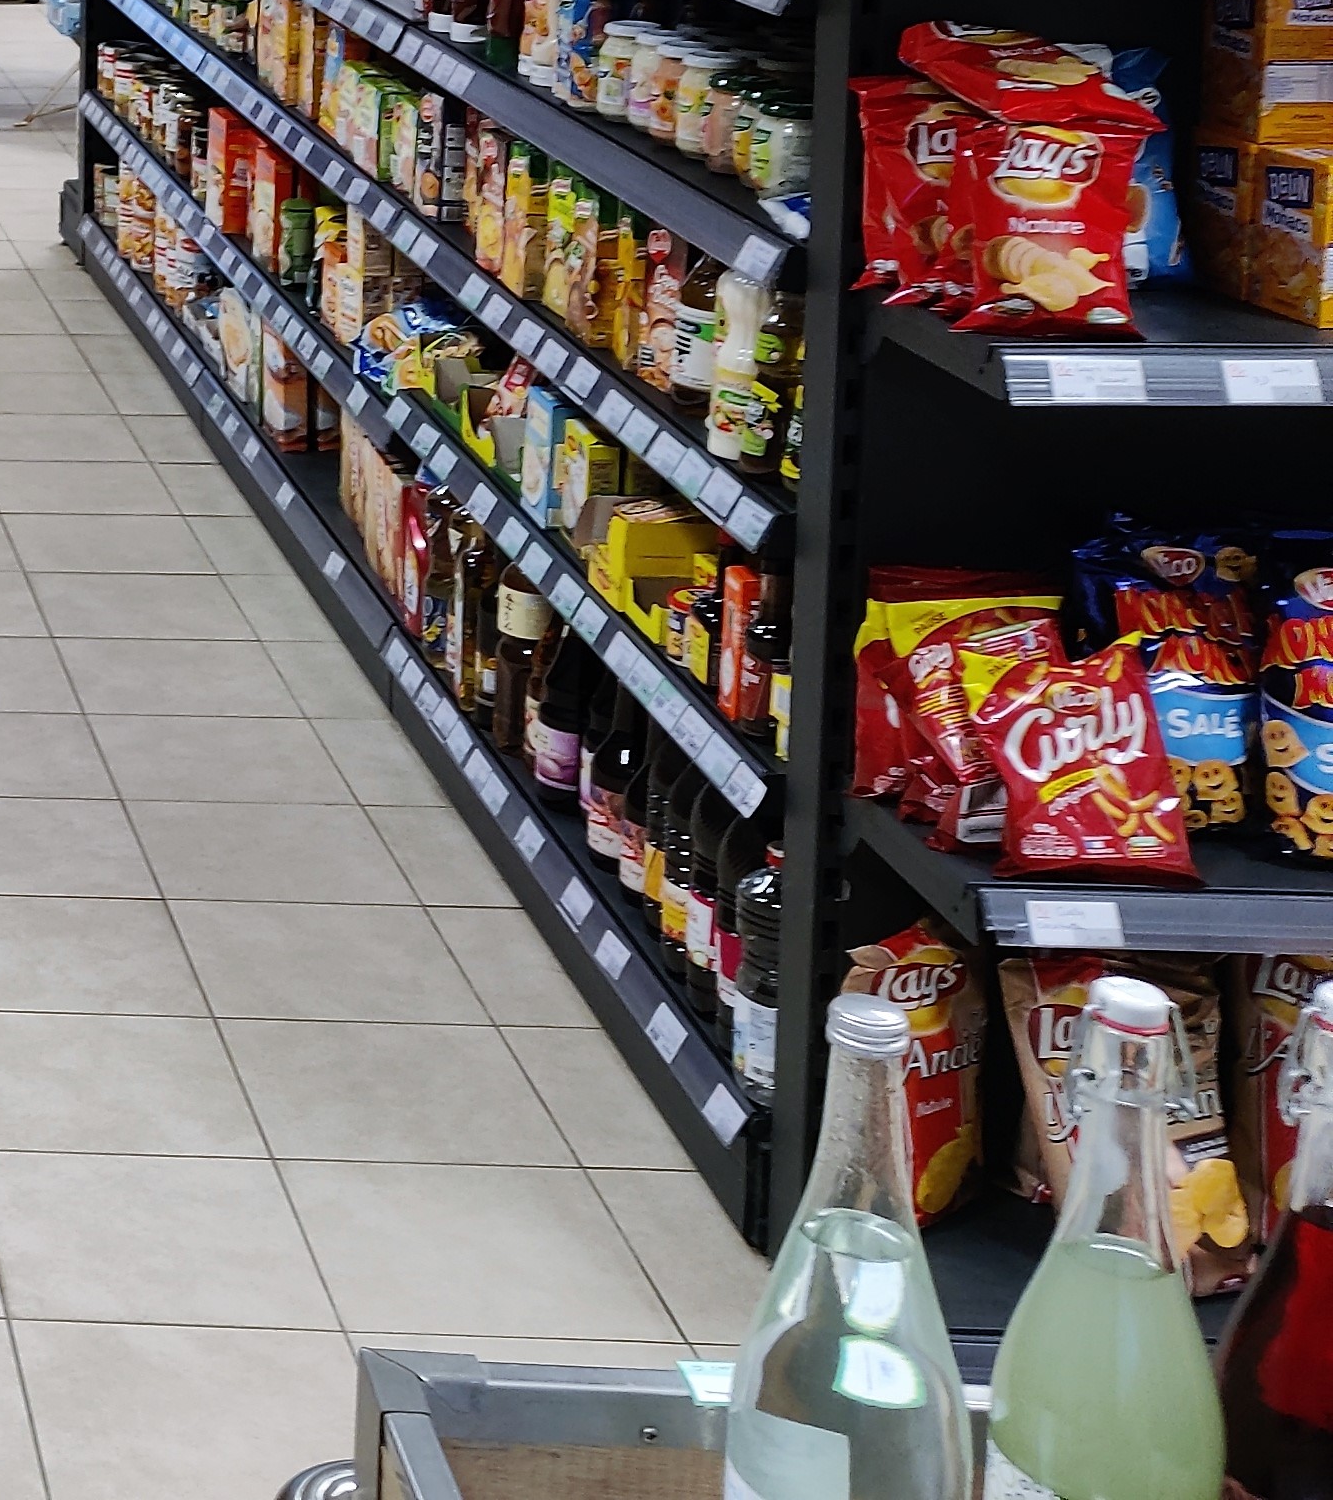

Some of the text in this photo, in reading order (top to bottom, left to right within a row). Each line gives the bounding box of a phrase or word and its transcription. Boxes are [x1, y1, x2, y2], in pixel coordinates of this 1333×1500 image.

[1004, 686, 1148, 783] Curly
[1166, 708, 1244, 740] SALÉ
[904, 1031, 983, 1079] Ancie
